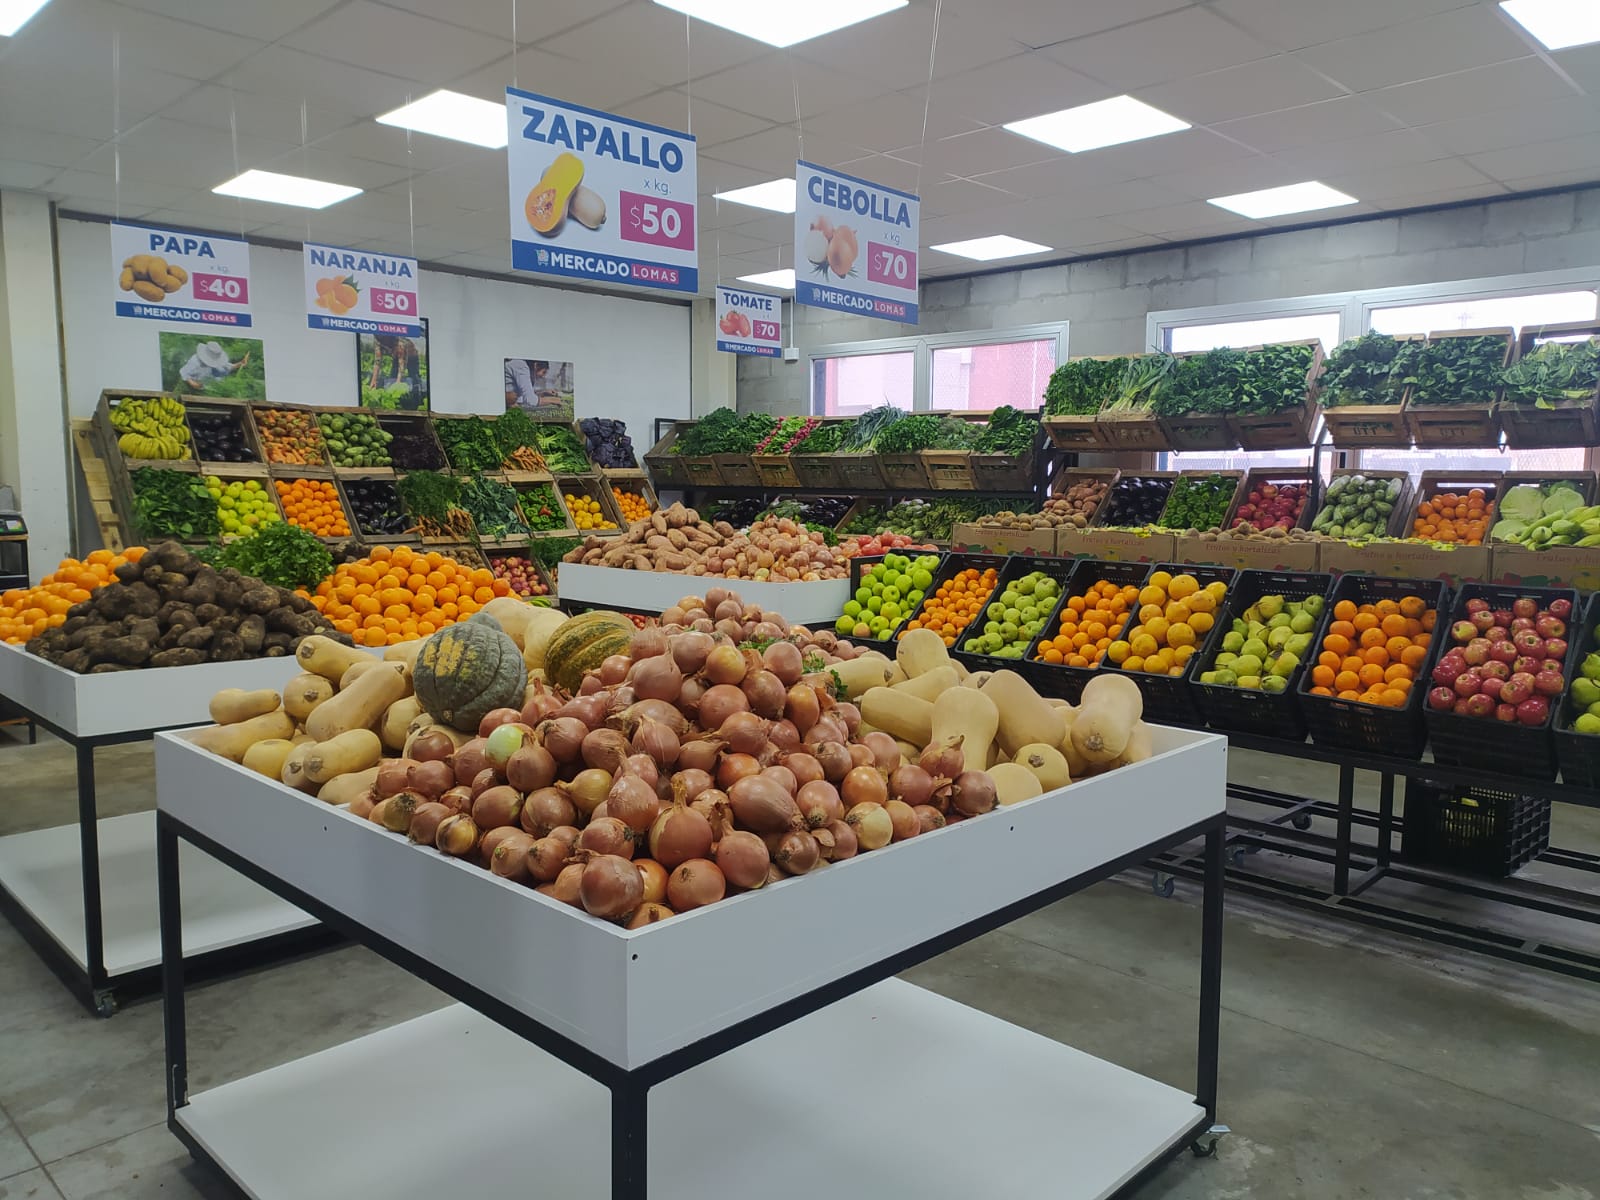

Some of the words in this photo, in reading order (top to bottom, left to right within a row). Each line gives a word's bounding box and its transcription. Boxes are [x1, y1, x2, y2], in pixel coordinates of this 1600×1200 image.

[522, 105, 683, 173] ZAPALLO
[643, 178, 650, 189] x
[654, 178, 672, 196] kg.
[808, 175, 911, 229] CEBOLLA
[630, 203, 682, 239] $50
[150, 233, 216, 258] PAPA
[310, 248, 412, 279] NARANJA
[551, 252, 630, 277] MERCADO
[633, 265, 677, 282] LOMAS
[874, 251, 908, 280] $70
[200, 279, 240, 298] $40
[377, 293, 409, 311] $50
[723, 292, 772, 311] TOMATE
[822, 289, 874, 311] MERCADO
[874, 301, 905, 316] LOMAS
[143, 306, 200, 321] MERCADO
[202, 313, 237, 323] LOMAS
[330, 317, 377, 331] MERCADO
[378, 324, 407, 334] LOMAS
[756, 323, 776, 337] $70
